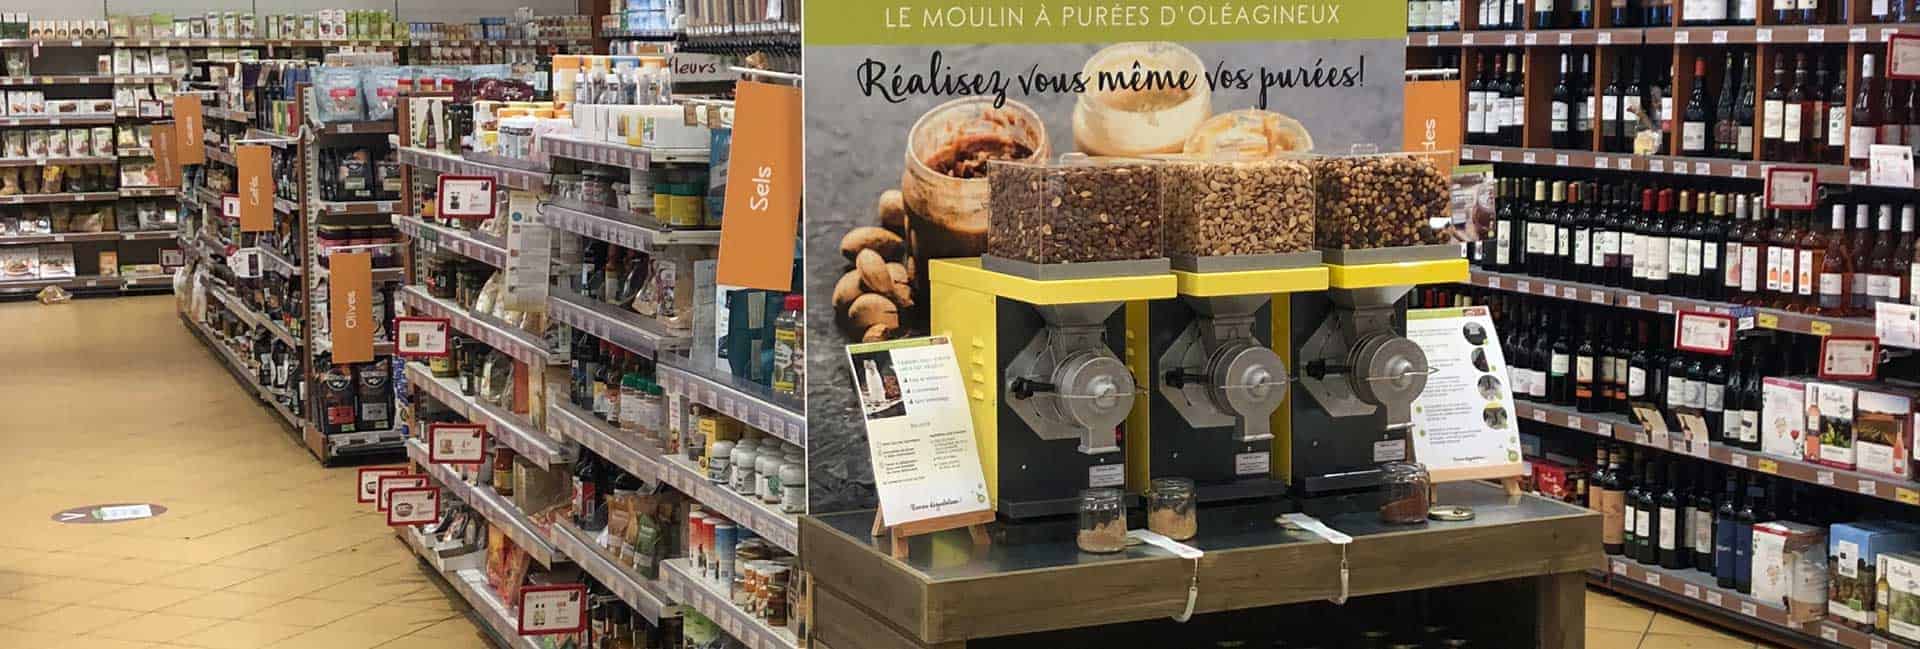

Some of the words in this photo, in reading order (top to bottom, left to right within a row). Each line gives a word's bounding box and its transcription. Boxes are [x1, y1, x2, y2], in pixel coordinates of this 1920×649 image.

[885, 6, 911, 28] LE
[923, 6, 1023, 28] MOULIN
[1035, 3, 1050, 27] À
[1064, 2, 1149, 27] PURÉES
[1160, 2, 1341, 26] D'OLÉAGINEUX
[856, 50, 1011, 109] Réalisez
[1018, 61, 1092, 97] vous
[1098, 59, 1199, 93] même
[1205, 60, 1258, 93] vos
[1257, 54, 1366, 111] purées!
[749, 167, 772, 211] Sels
[345, 290, 357, 330] Olives
